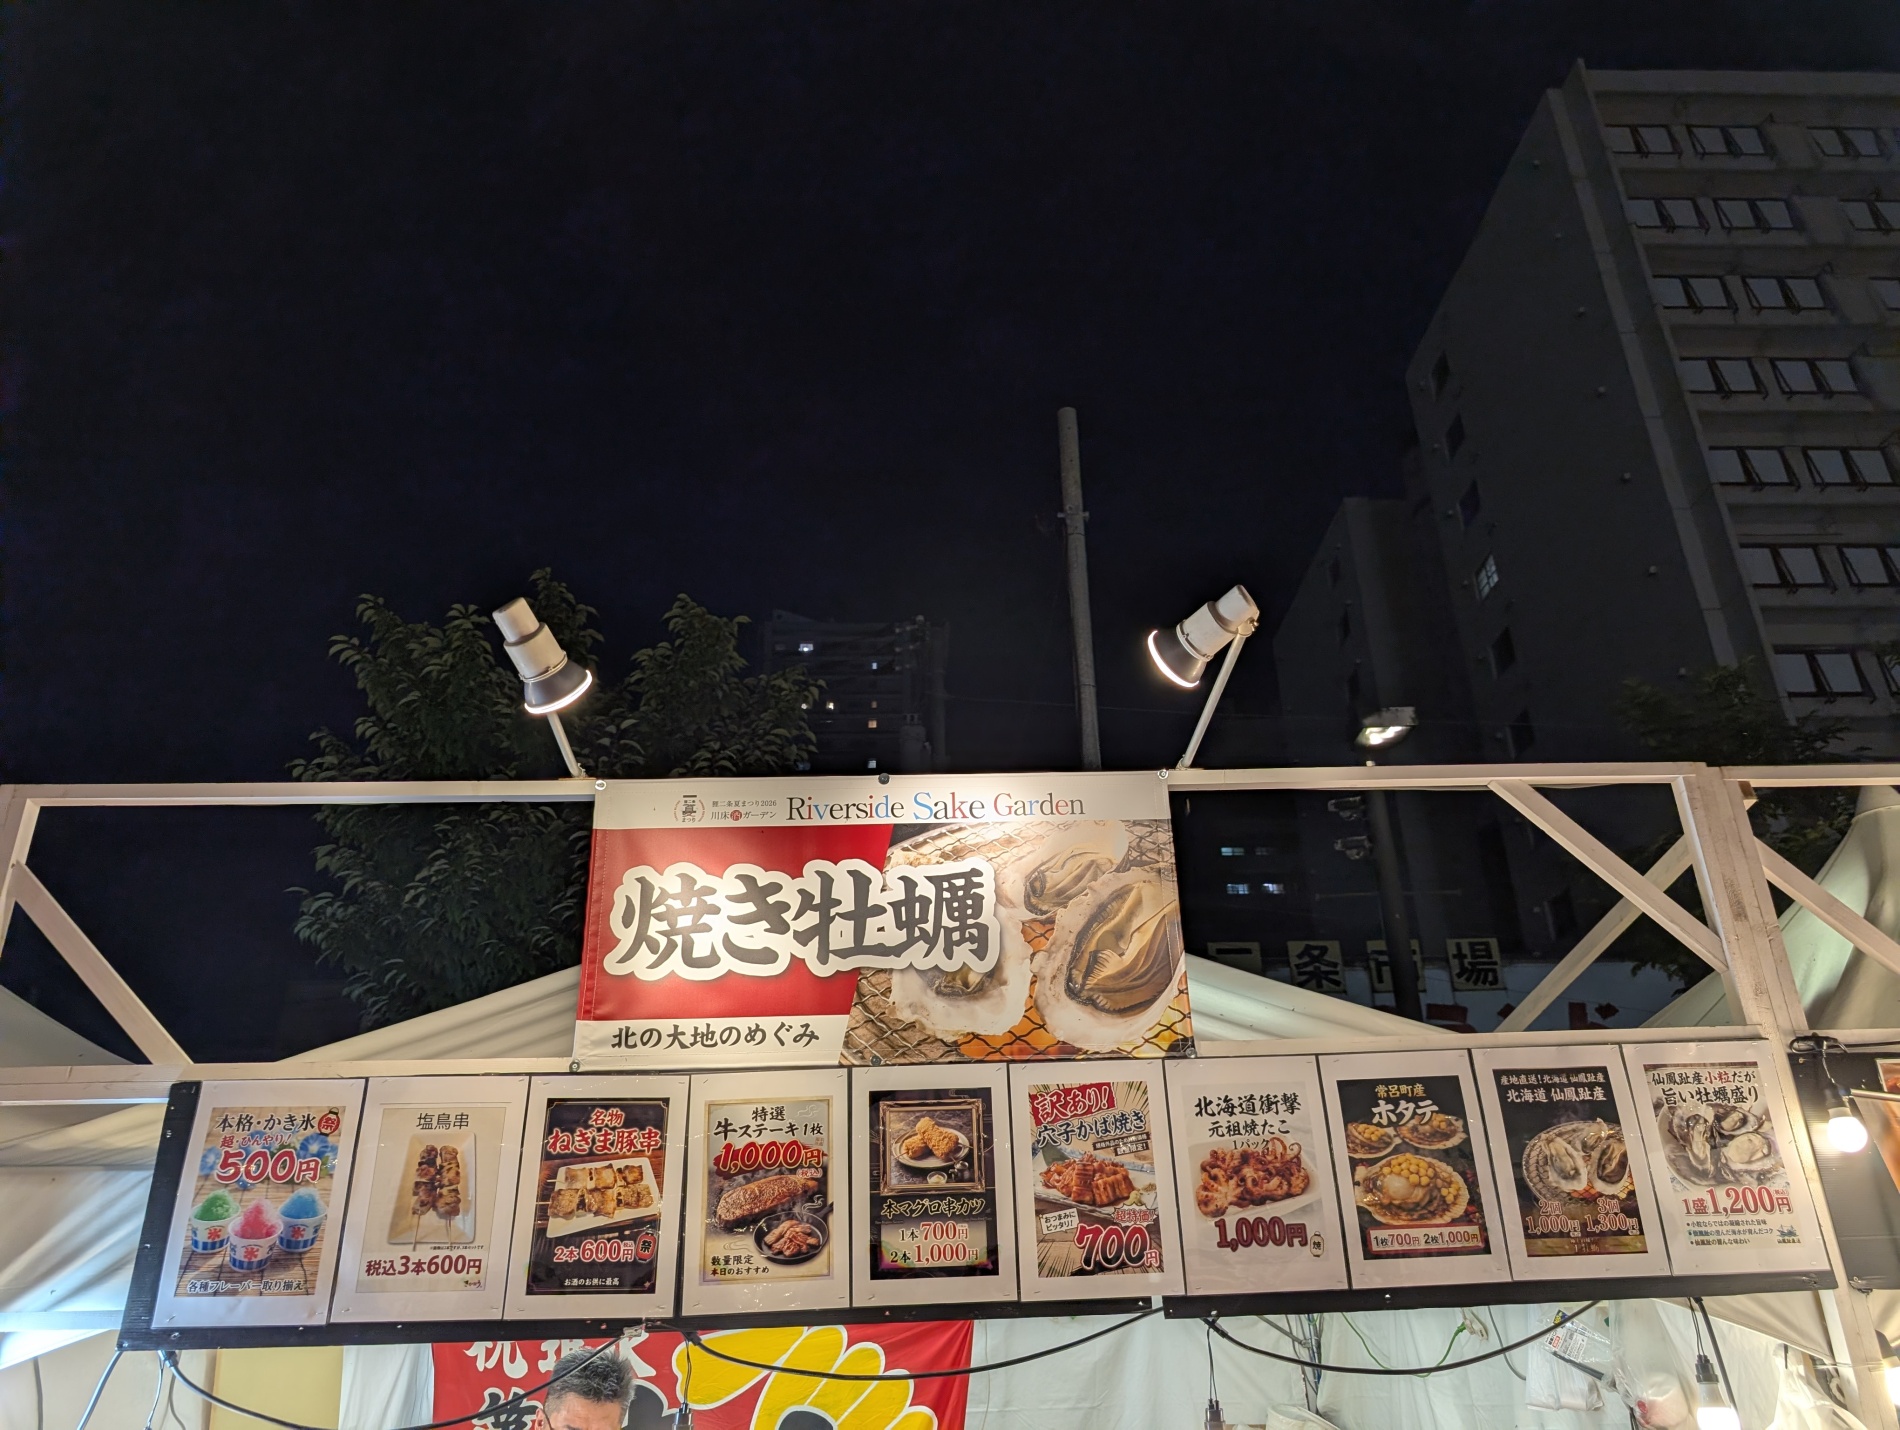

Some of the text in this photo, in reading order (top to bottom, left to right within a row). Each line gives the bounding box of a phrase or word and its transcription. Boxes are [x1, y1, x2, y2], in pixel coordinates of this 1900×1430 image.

[786, 791, 1086, 821] Riverside Sake Garden
[616, 868, 990, 970] 焼き牡蠣
[611, 1023, 820, 1050] 北の大地のめぐみ
[1375, 1083, 1427, 1098] 常呂町産
[1507, 1088, 1548, 1103] 北海道
[1661, 1085, 1759, 1105] 旨い牡蠣盛り
[752, 1106, 785, 1121] 特選
[1034, 1085, 1109, 1122] 訳あり!
[1194, 1092, 1302, 1117] 北海道衝撃
[1371, 1099, 1440, 1126] ホタテ
[215, 1113, 316, 1132] 本格・かき氷
[416, 1112, 469, 1130] 塩鳥串
[590, 1109, 624, 1126] 名物
[1037, 1109, 1146, 1147] 穴子かば焼き
[1208, 1119, 1290, 1137] 元祖焼たこ
[548, 1127, 661, 1153] ねぎま豚串
[215, 1149, 321, 1183] 500円
[719, 1139, 823, 1172] 1,000円
[881, 1197, 985, 1219] 本マグロ串カツ
[1683, 1186, 1792, 1218] 1盛1,200円
[1074, 1223, 1159, 1270] 700円
[1214, 1216, 1309, 1252] 1,000円
[365, 1255, 482, 1276] 税込3本600円
[710, 1266, 769, 1277] 本日のおすすめ
[711, 1254, 754, 1266] 数量限定
